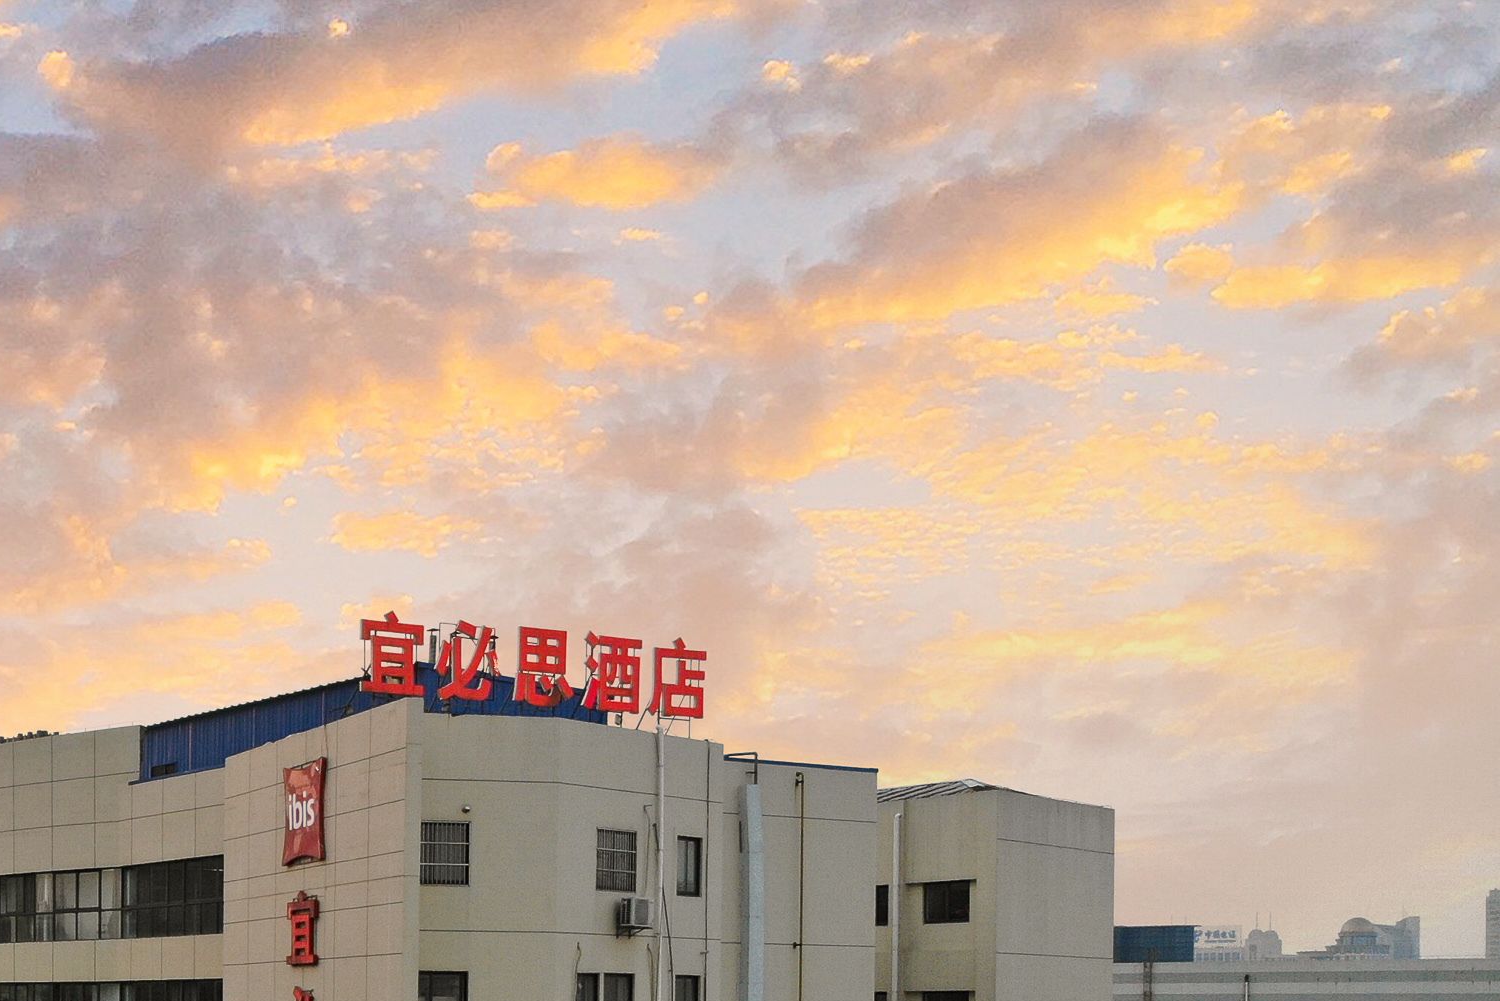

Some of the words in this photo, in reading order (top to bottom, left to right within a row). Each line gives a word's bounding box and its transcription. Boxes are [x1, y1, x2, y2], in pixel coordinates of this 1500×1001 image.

[359, 611, 707, 718] 宜必思酒店
[286, 793, 315, 831] ibis
